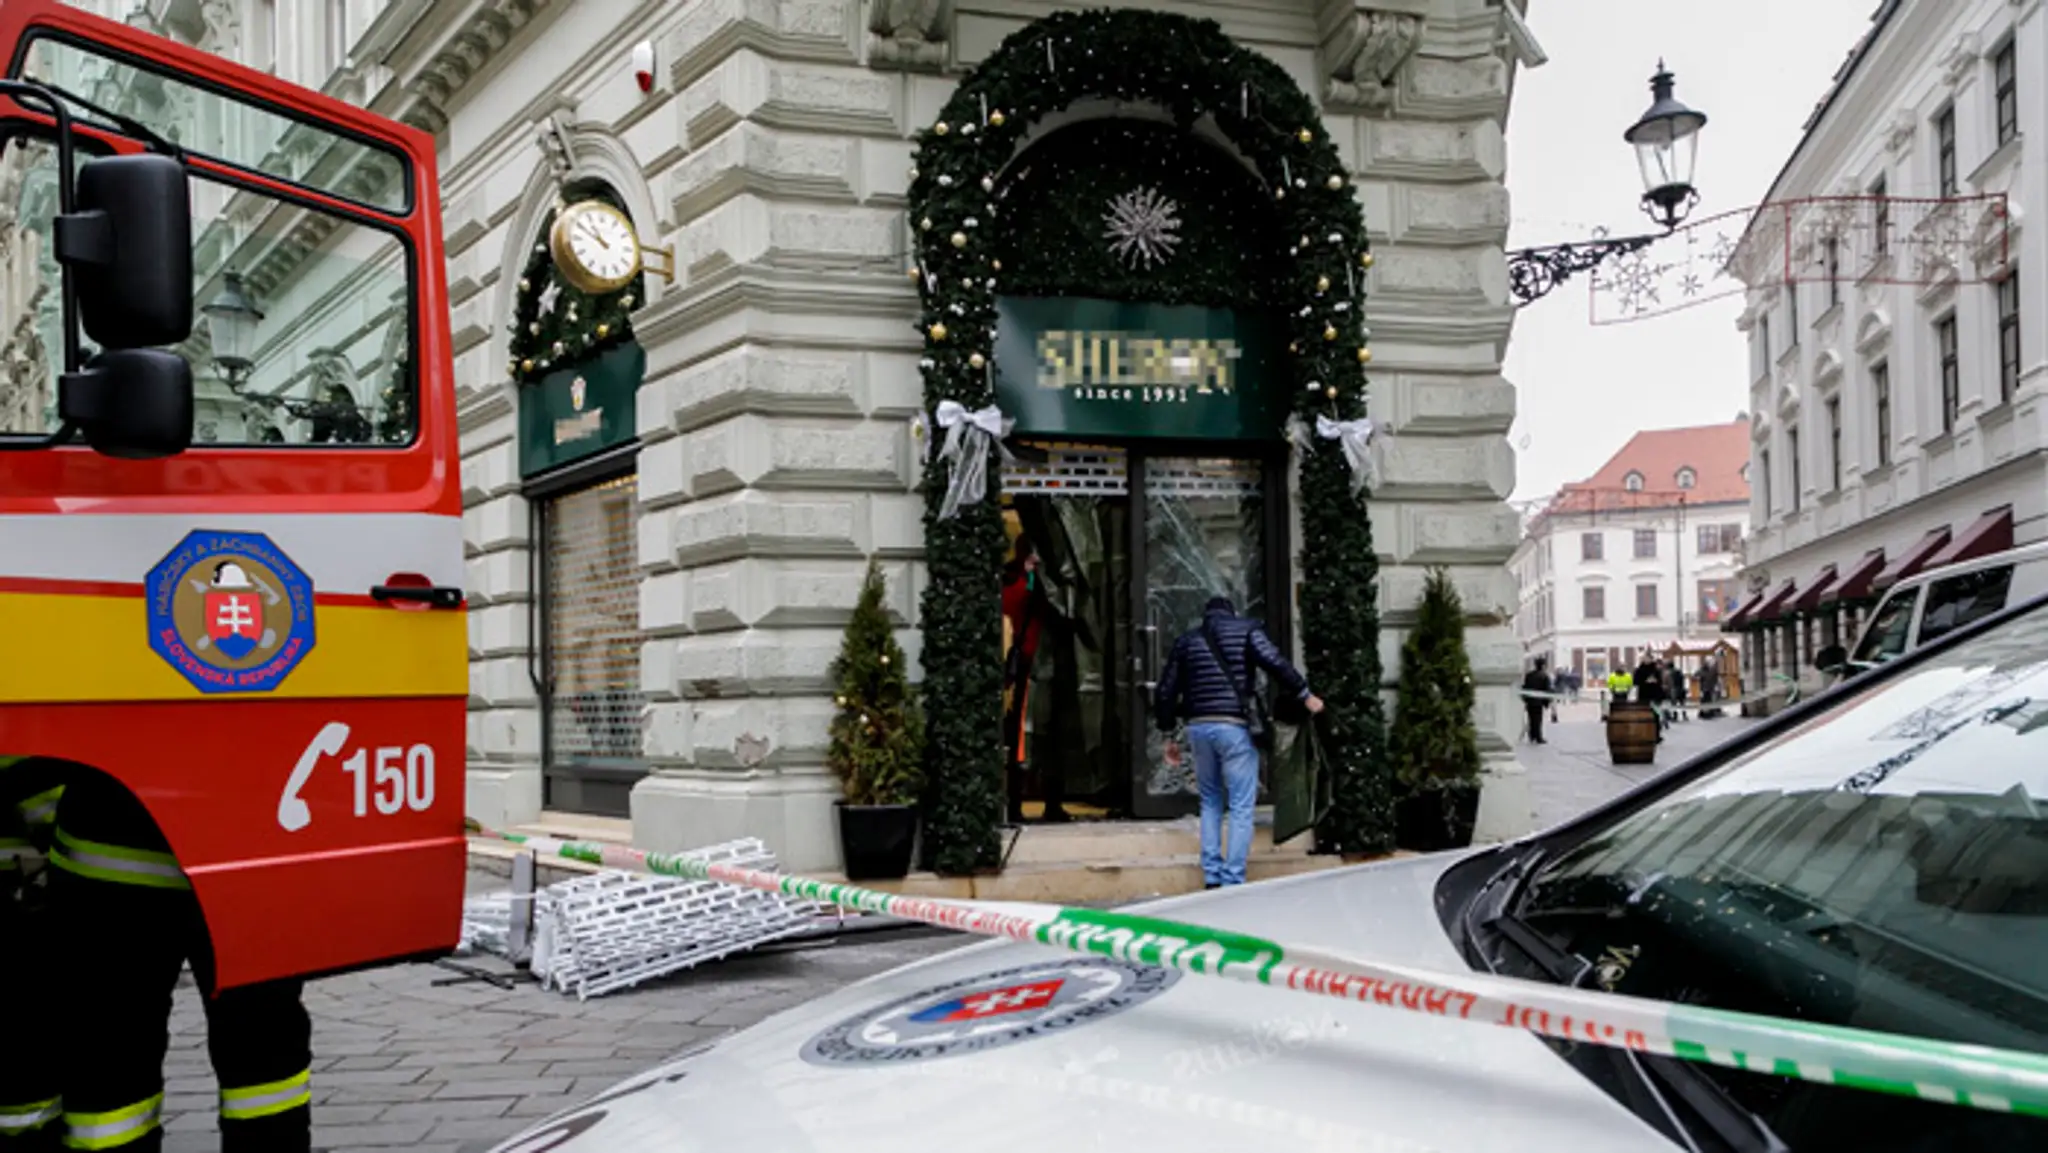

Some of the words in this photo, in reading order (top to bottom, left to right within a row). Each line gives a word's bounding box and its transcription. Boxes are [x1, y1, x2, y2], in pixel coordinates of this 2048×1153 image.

[1074, 386, 1132, 400] since
[1143, 386, 1187, 402] 1991
[343, 744, 434, 816] 150
